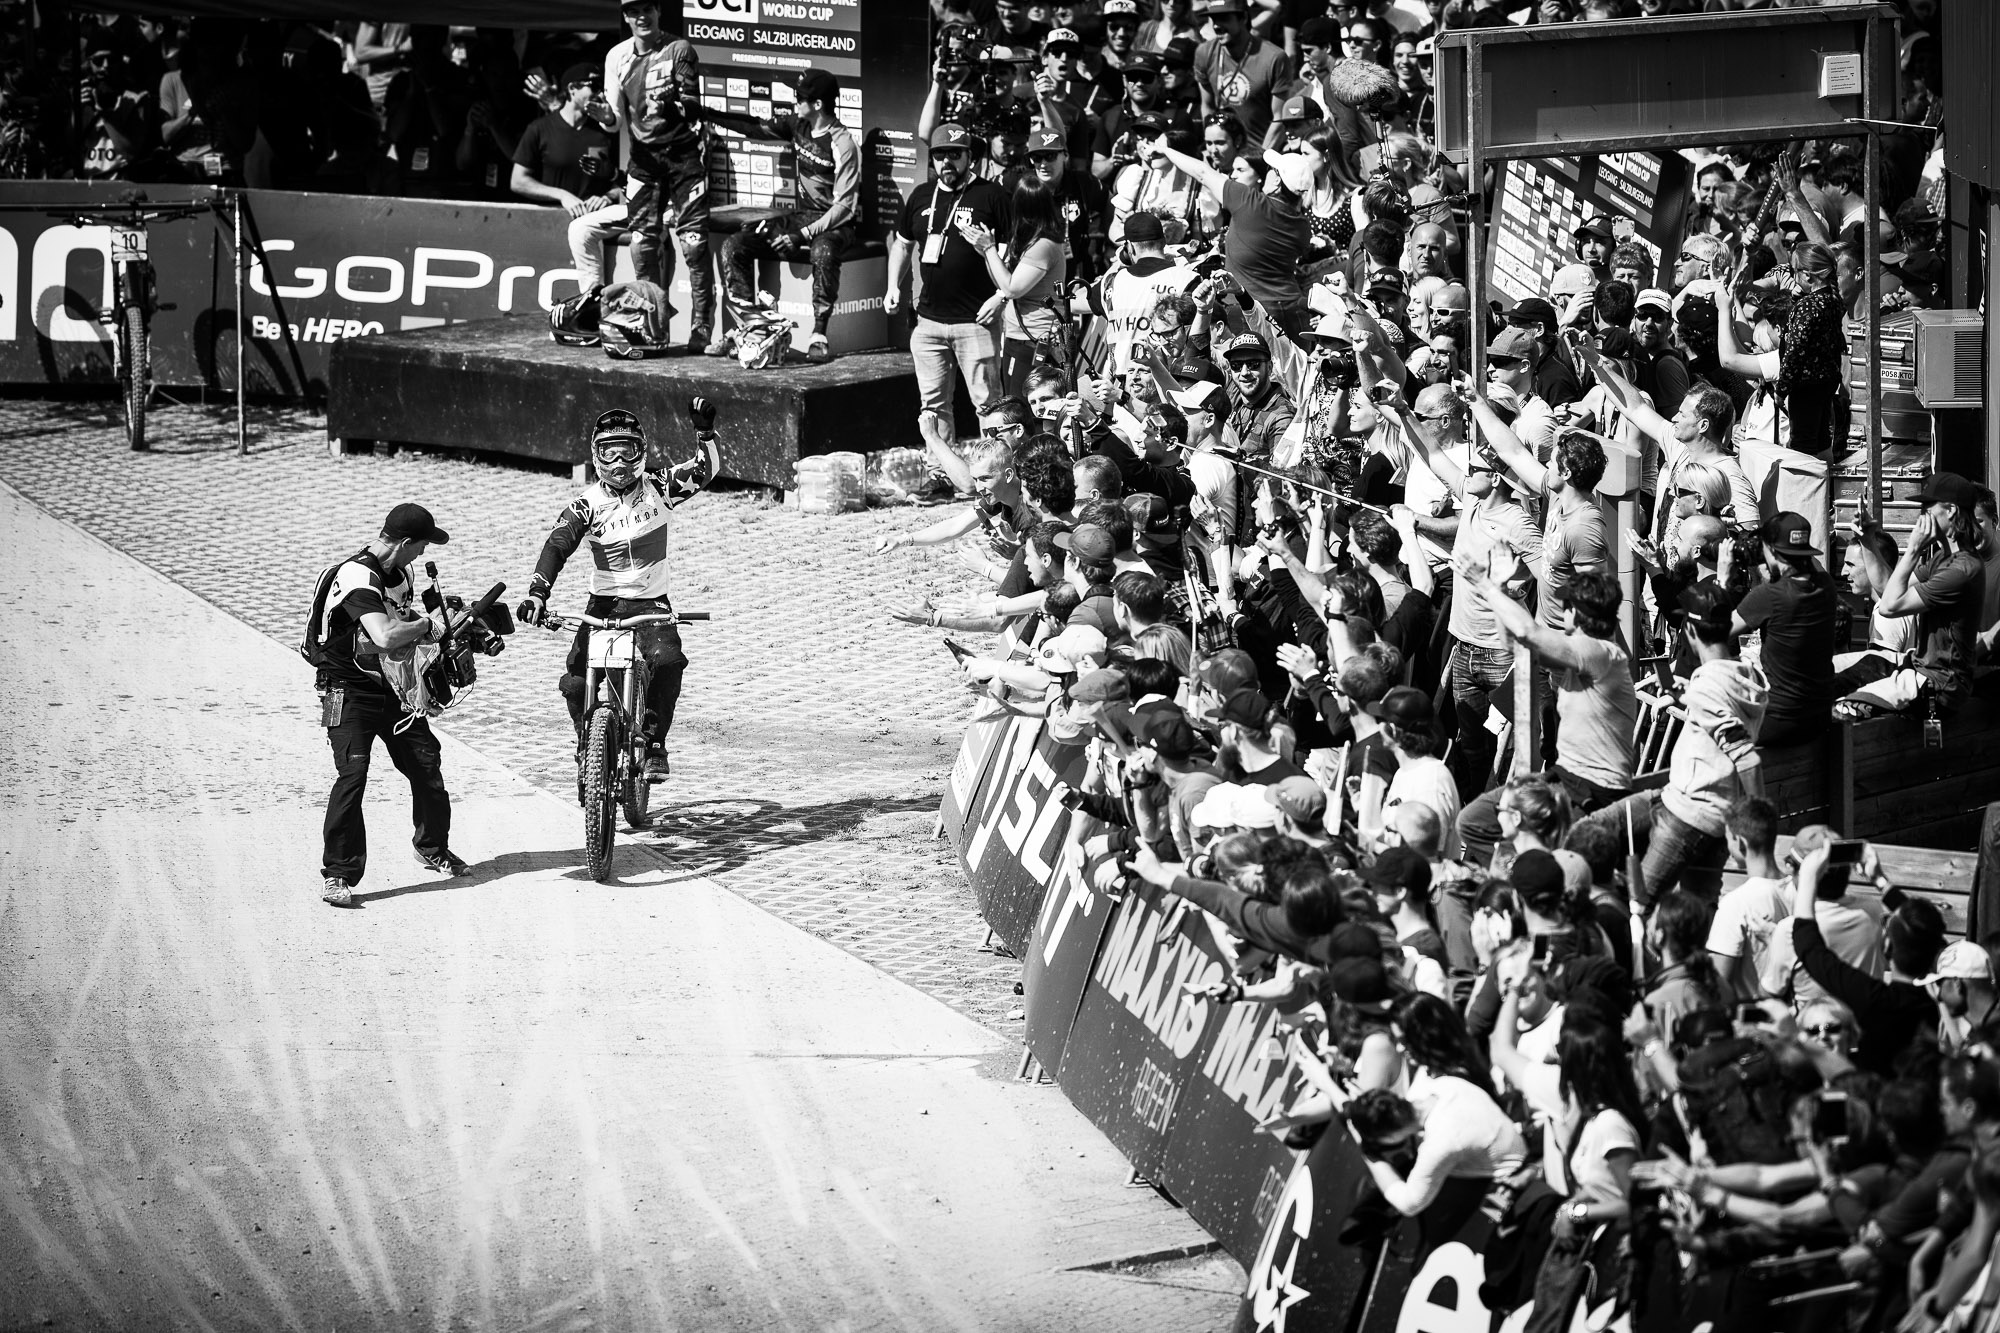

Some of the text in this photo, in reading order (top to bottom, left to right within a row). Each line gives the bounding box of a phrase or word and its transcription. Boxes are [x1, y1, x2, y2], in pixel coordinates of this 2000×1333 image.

[762, 3, 834, 21] WORLD CUP
[688, 24, 856, 51] LEOGANG SALZBURGERLAND
[1598, 165, 1619, 187] LEOGANG
[1626, 159, 1651, 182] WORLD CUP
[122, 233, 138, 250] 10
[252, 315, 281, 340] Be
[606, 637, 614, 656] 1
[1094, 889, 1225, 1060] MAXXIS
